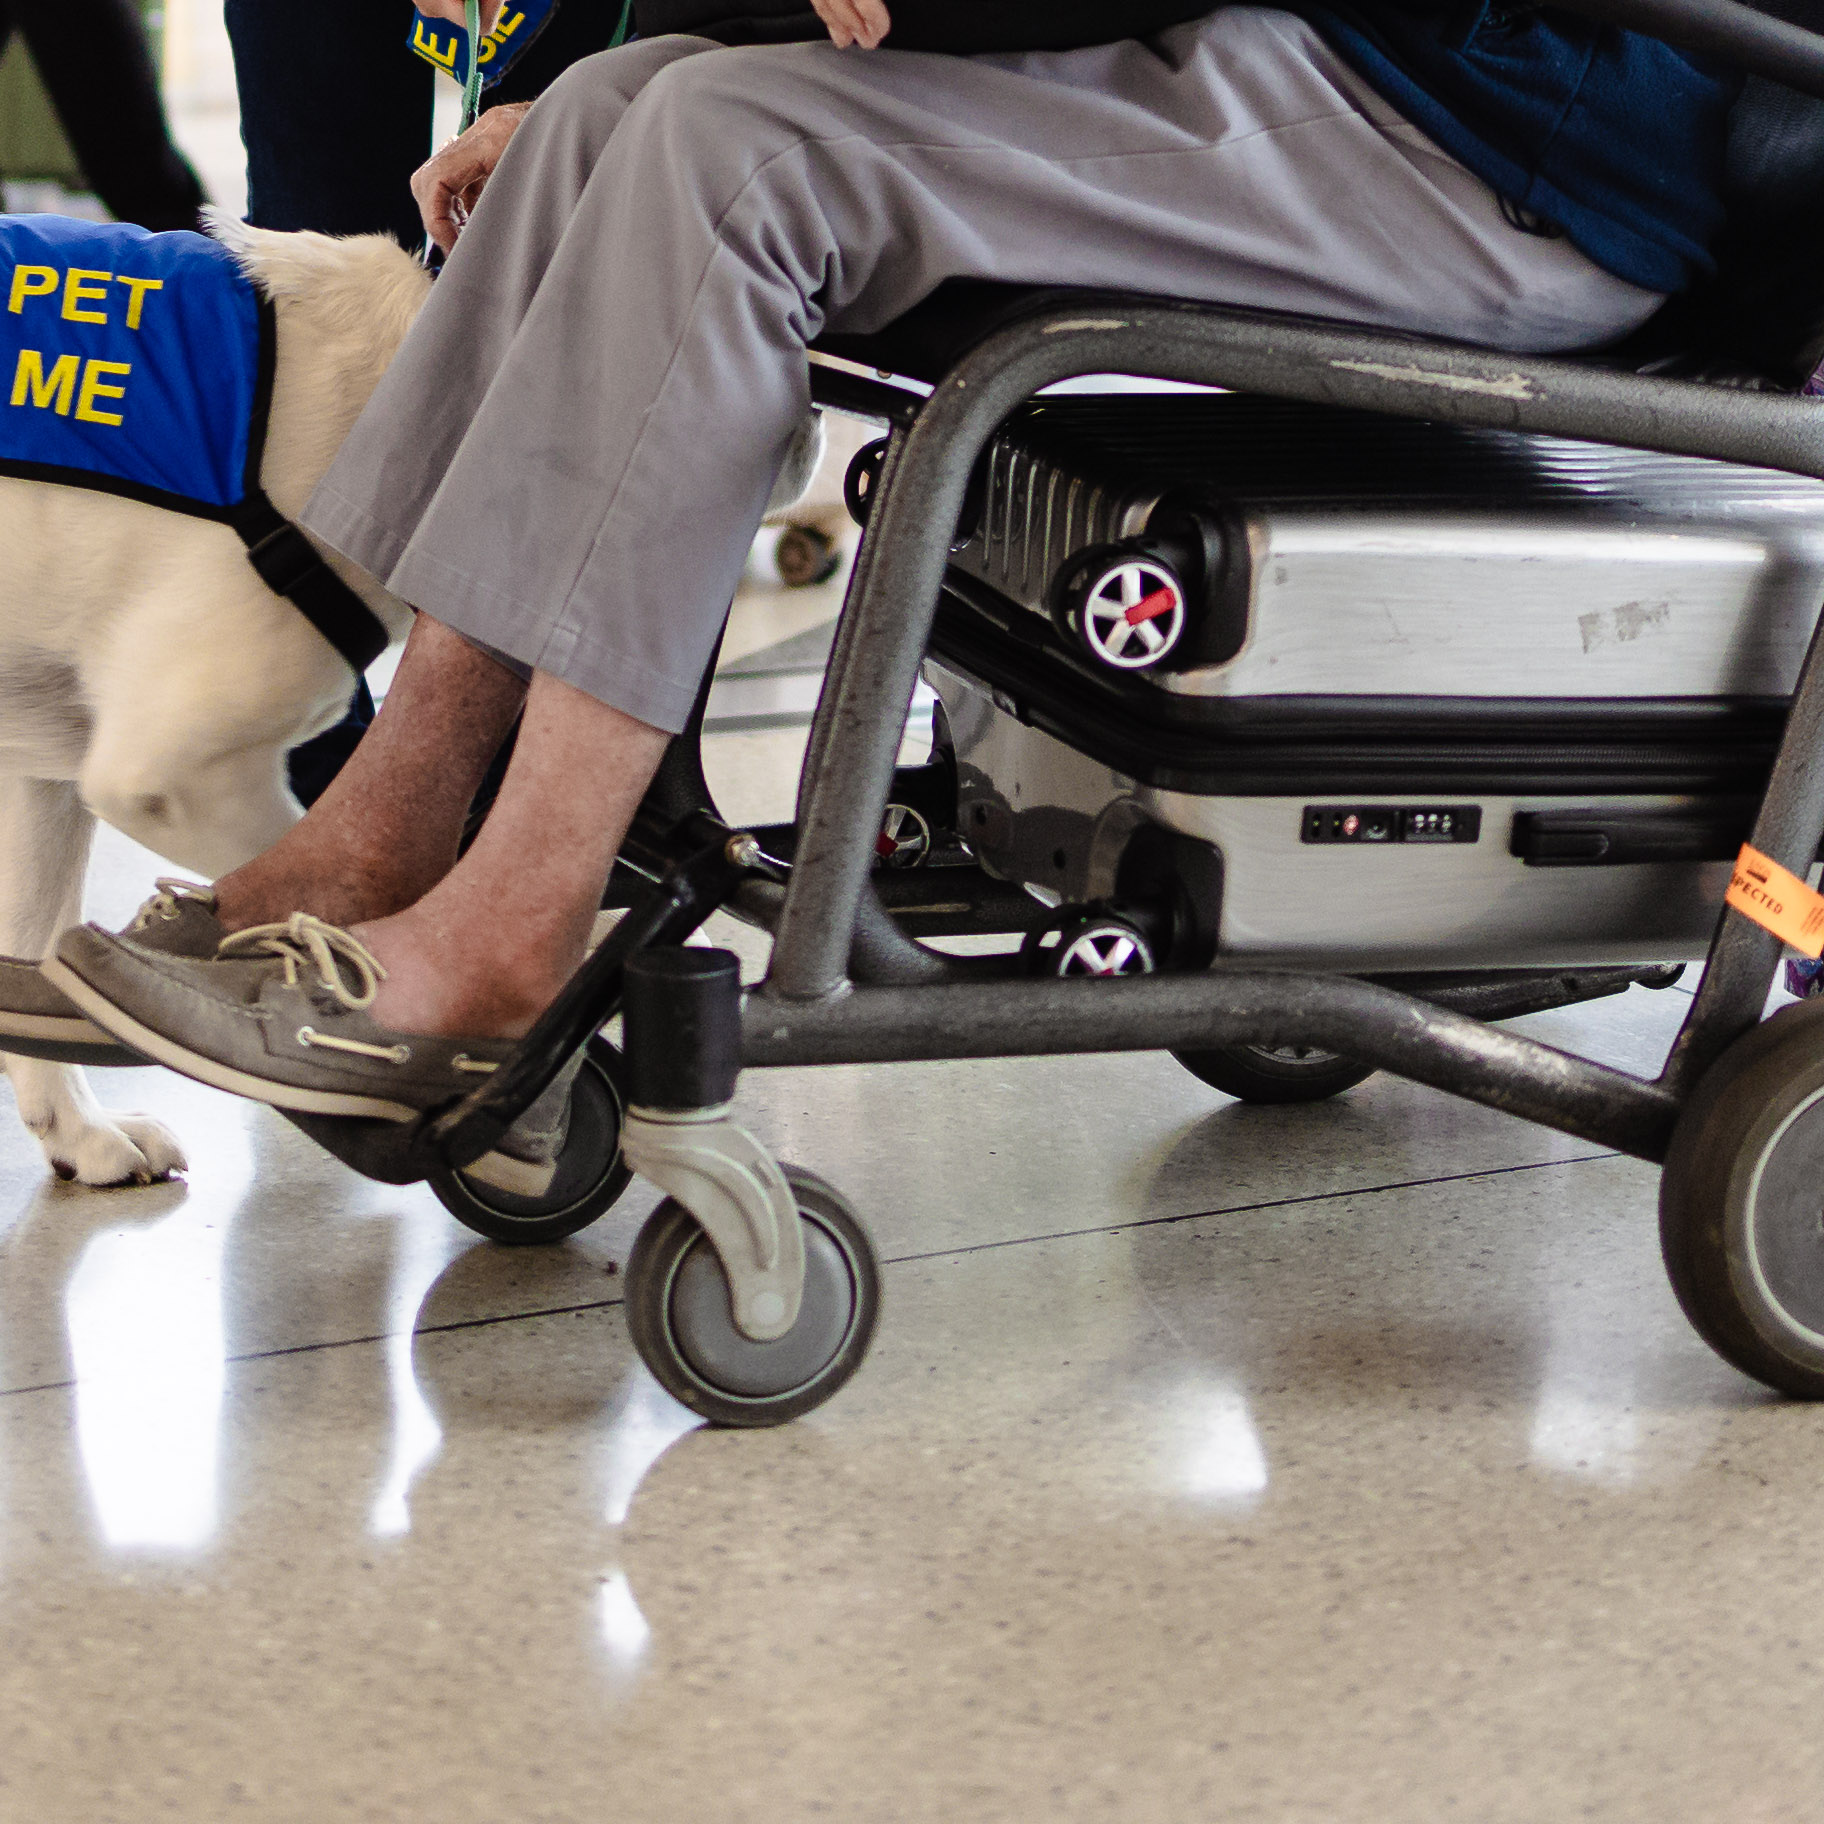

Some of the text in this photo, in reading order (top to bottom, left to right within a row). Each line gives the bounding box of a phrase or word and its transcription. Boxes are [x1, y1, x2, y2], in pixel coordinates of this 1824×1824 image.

[7, 264, 164, 331] PET
[9, 349, 132, 427] ME
[1732, 876, 1784, 916] PECTED
